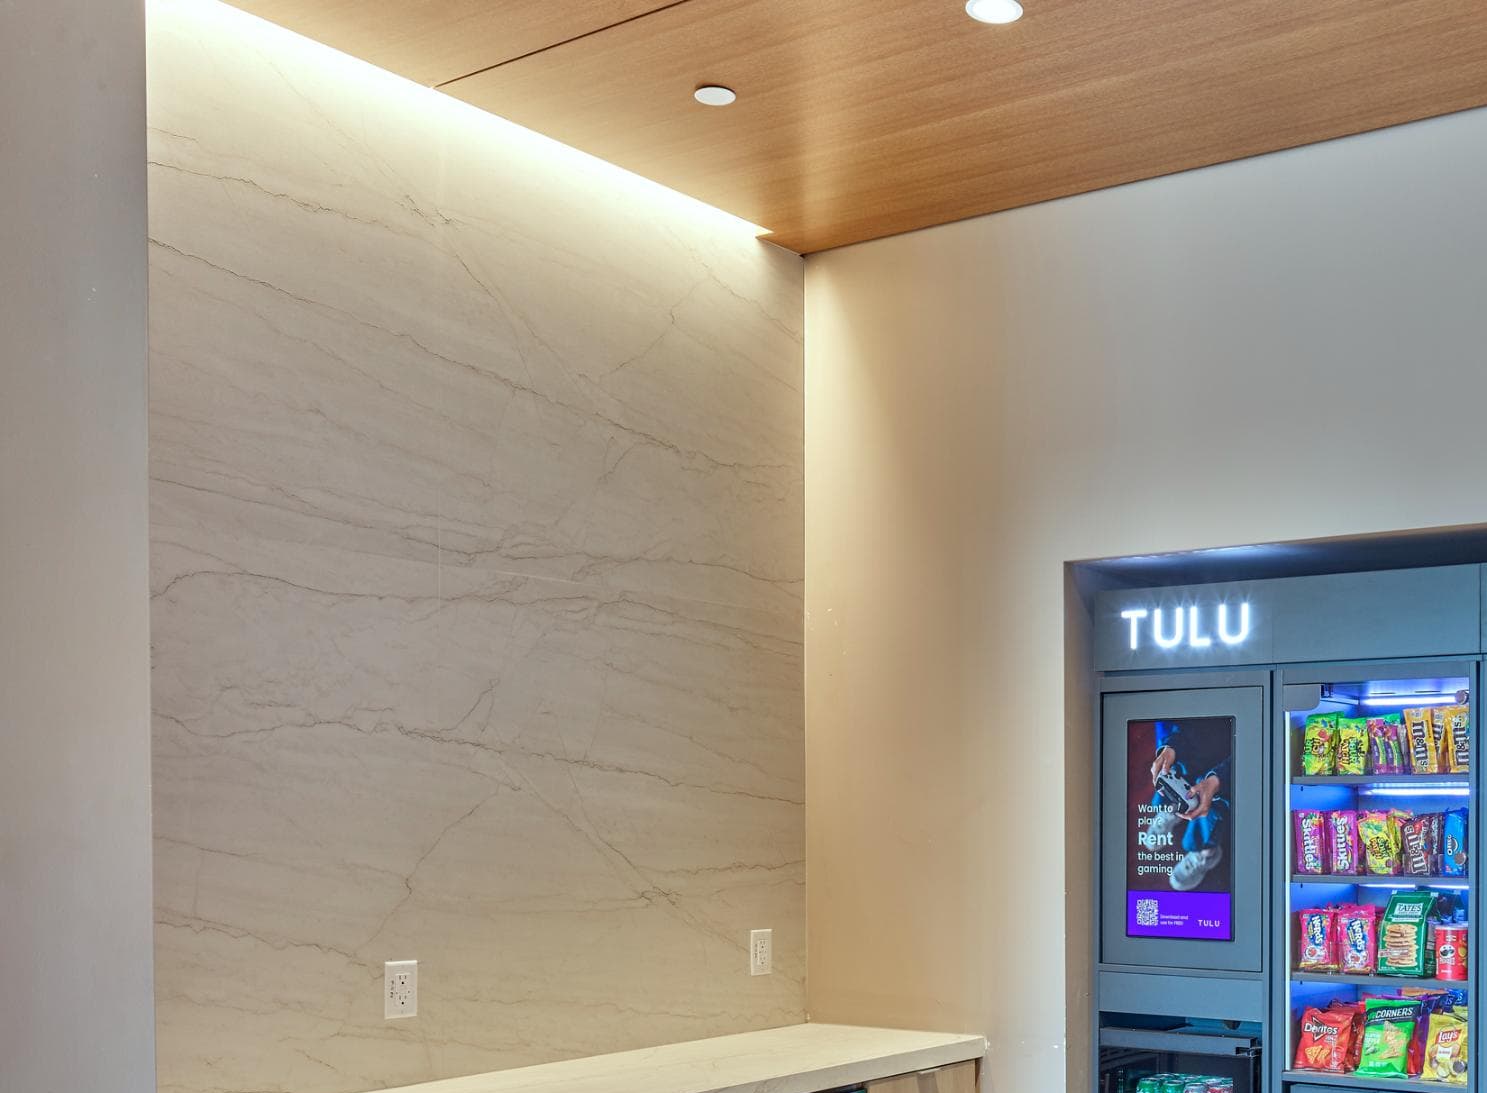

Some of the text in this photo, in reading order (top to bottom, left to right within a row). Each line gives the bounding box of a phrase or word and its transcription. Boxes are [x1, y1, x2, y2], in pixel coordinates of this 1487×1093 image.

[1120, 602, 1251, 650] TULU
[1138, 804, 1174, 813] Want to
[1138, 815, 1163, 828] play?
[1138, 832, 1174, 846] Rent
[1302, 818, 1316, 870] Skittles
[1138, 852, 1185, 861] the best in
[1138, 865, 1174, 876] gaming
[1198, 919, 1221, 928] TULU
[1304, 1022, 1339, 1035] Doritos
